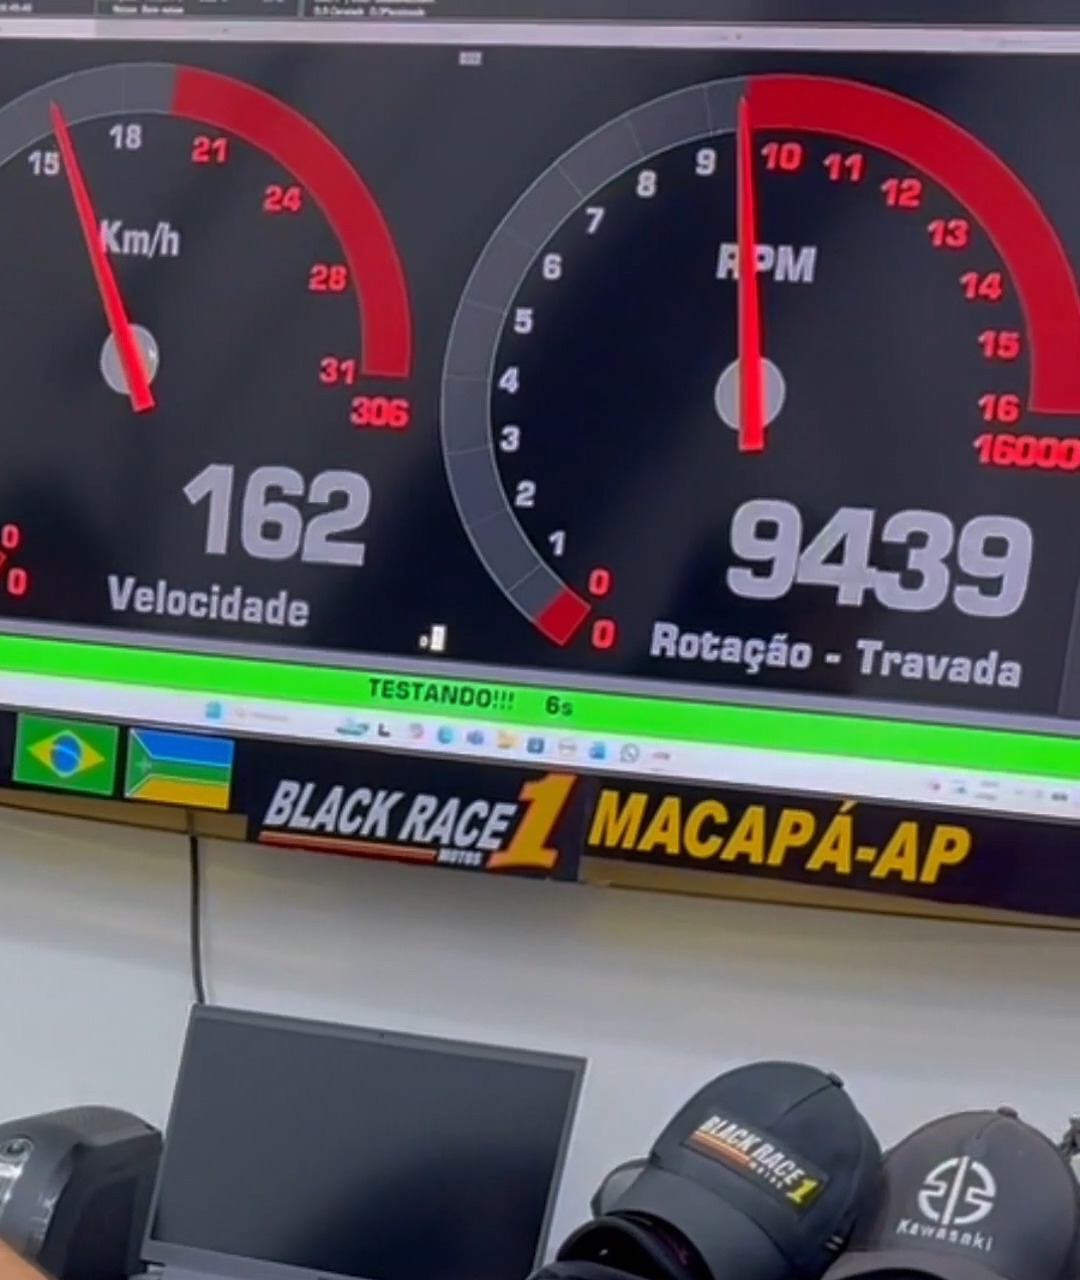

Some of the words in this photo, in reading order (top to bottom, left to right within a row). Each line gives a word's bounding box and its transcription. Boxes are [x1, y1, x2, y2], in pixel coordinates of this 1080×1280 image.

[110, 125, 142, 149] 18
[193, 137, 228, 163] 21
[29, 151, 60, 176] 15
[696, 149, 715, 175] 9
[762, 143, 802, 170] 10
[824, 154, 864, 181] 11
[637, 171, 656, 197] 8
[882, 179, 921, 207] 12
[264, 187, 301, 212] 24
[586, 208, 604, 233] 7
[929, 219, 968, 246] 13
[100, 219, 180, 258] Km/h
[543, 254, 562, 280] 6
[716, 242, 817, 283] RPM
[309, 266, 346, 291] 28
[962, 273, 1002, 299] 14
[514, 309, 533, 334] 5
[979, 332, 1019, 358] 15
[320, 359, 356, 384] 31
[499, 368, 519, 393] 4
[351, 397, 409, 428] 306
[978, 394, 1020, 422] 16
[500, 426, 520, 451] 3
[973, 434, 1080, 469] 16000
[515, 481, 535, 506] 2
[183, 464, 370, 566] 162
[1, 526, 19, 550] 0
[549, 531, 565, 555] 1
[727, 499, 1033, 617] 9439
[7, 569, 26, 595] 0
[590, 569, 609, 596] 0
[108, 575, 309, 627] Velocidade
[592, 620, 615, 650] 0
[651, 622, 811, 672] Rotação
[857, 640, 1022, 688] Travada
[368, 678, 515, 711] TESTANDO!!!
[545, 695, 574, 717] 6s
[263, 779, 405, 838] BLACK
[397, 791, 518, 849] RACE
[485, 772, 578, 869] 1
[587, 789, 972, 884] MACAPÁ-AP
[698, 1115, 762, 1153] BLACK
[751, 1143, 806, 1186] RACE
[785, 1178, 819, 1204] 1
[896, 1218, 994, 1252] Kawasaki
